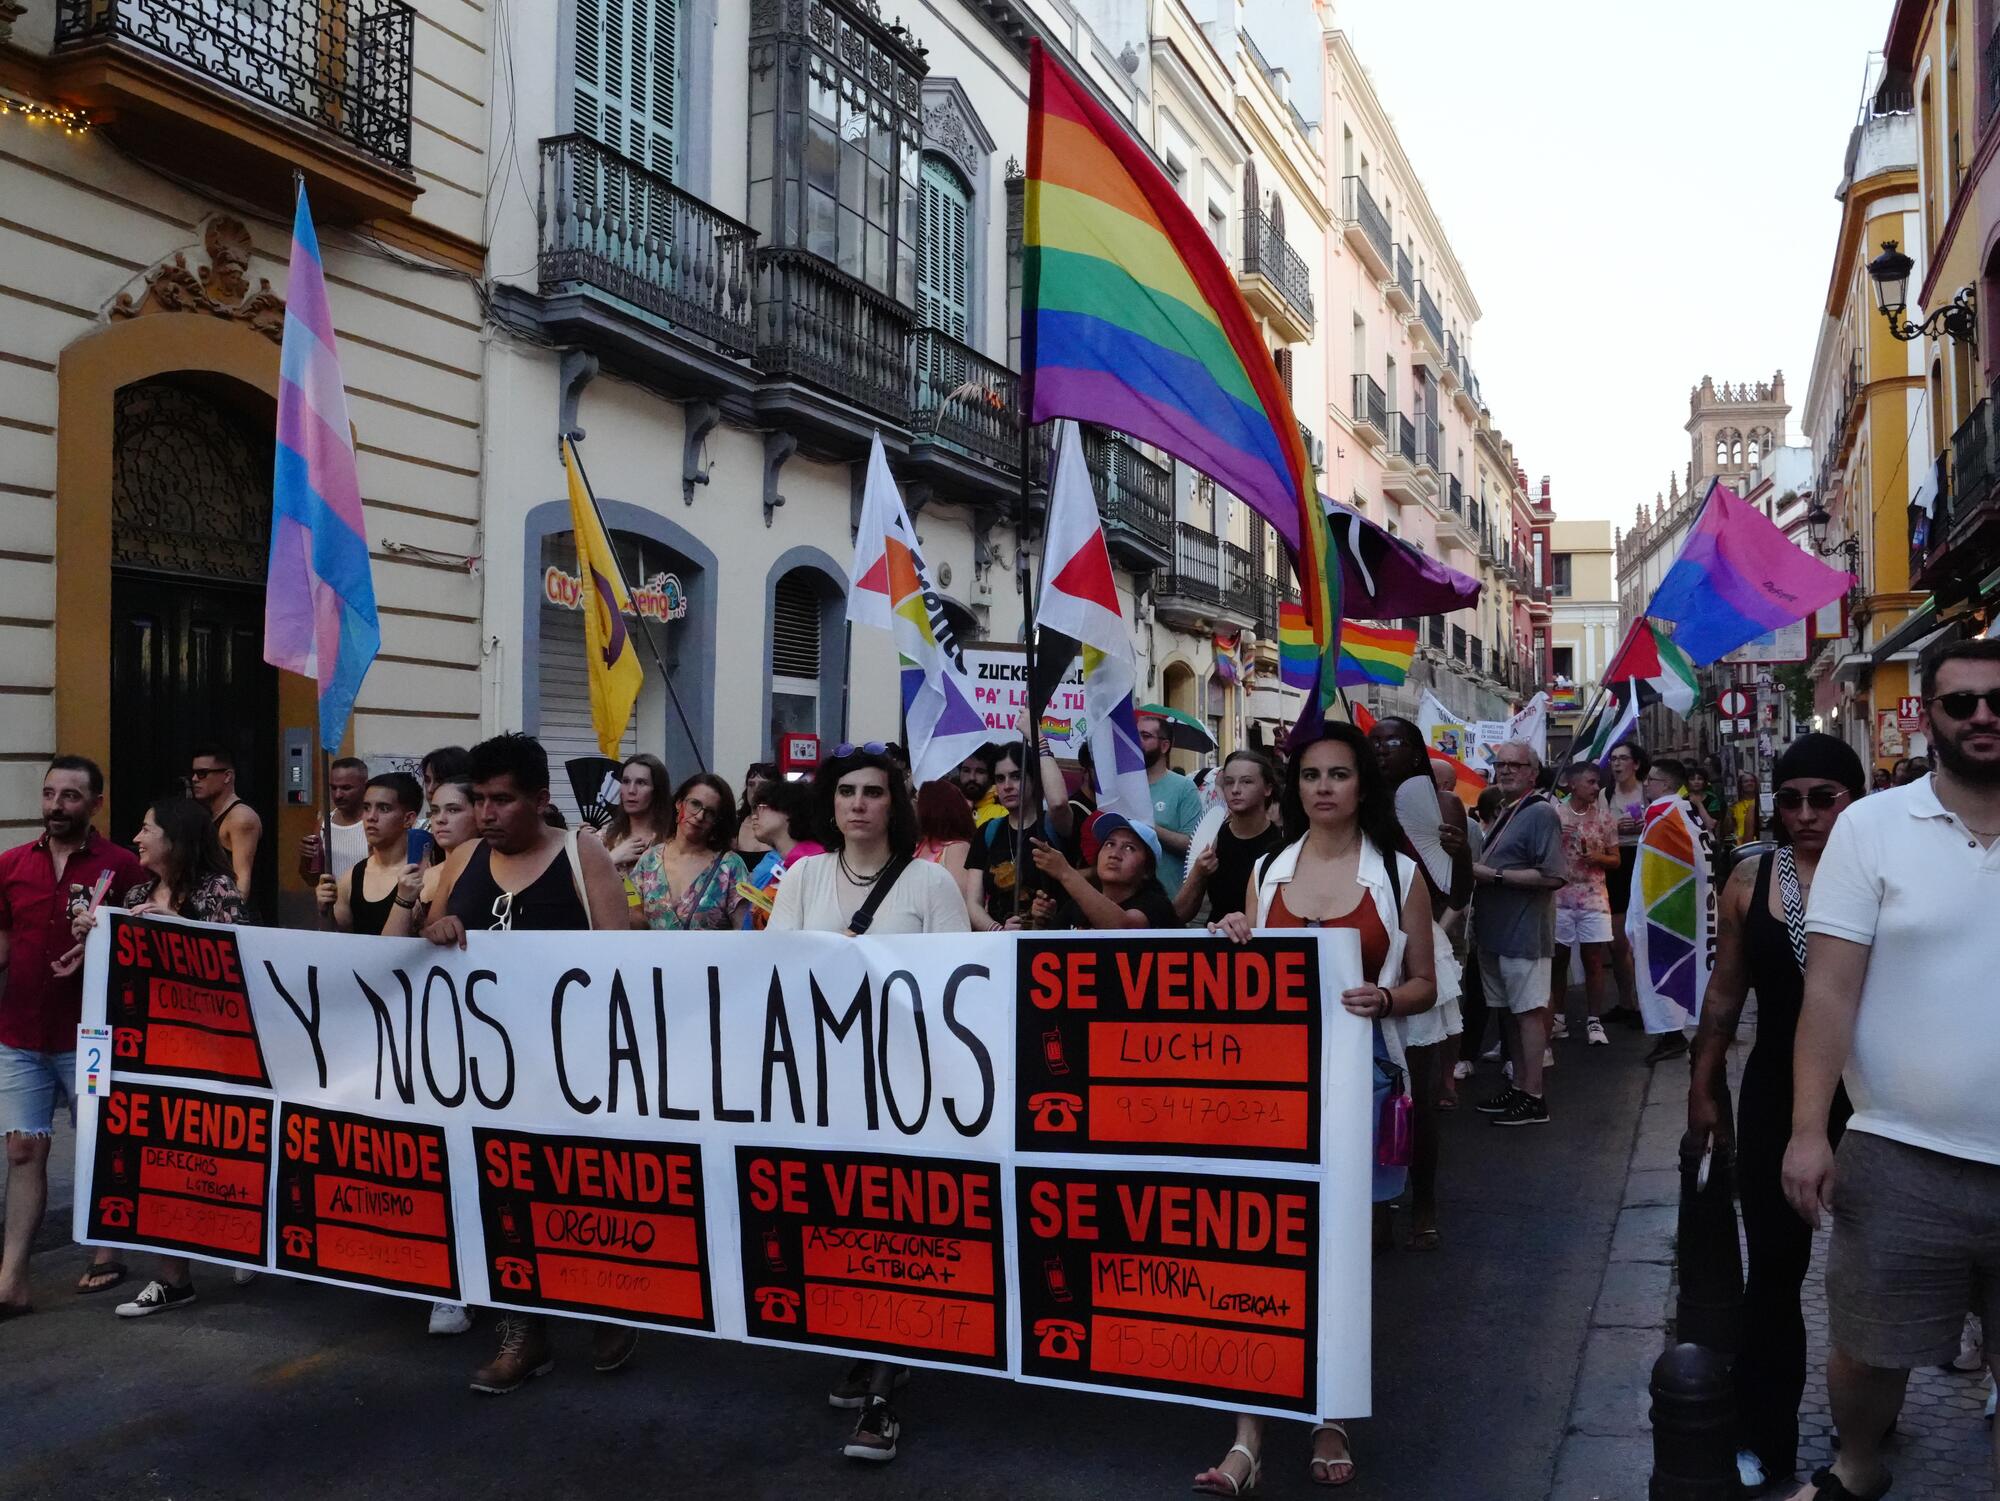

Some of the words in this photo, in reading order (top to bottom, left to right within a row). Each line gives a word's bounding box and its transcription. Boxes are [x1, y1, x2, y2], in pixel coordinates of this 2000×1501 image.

[547, 568, 582, 609] City
[117, 924, 152, 967] SE
[152, 929, 241, 984] VENDE
[158, 982, 239, 1019] COLECTIVO
[1029, 952, 1098, 1010] SE
[1115, 952, 1308, 1011] VENDE
[86, 1047, 101, 1072] 2
[263, 959, 327, 1089] Y
[352, 964, 516, 1111] NOS
[550, 963, 995, 1137] CALLAMOS
[1120, 1028, 1243, 1066] LUCHA
[106, 1090, 149, 1137] SE
[160, 1096, 267, 1153] VENDE
[1117, 1095, 1286, 1124] 954470371
[146, 1150, 218, 1176] DERECHOS
[285, 1113, 320, 1164] SE
[329, 1121, 442, 1183] VENDE
[485, 1139, 534, 1191] SE
[543, 1146, 694, 1206] VENDE
[749, 1158, 809, 1214] SE
[822, 1163, 992, 1230] VENDE
[329, 1183, 413, 1216] ACTIVISMO
[1029, 1180, 1099, 1240] SE
[1117, 1184, 1307, 1257] VENDE
[546, 1209, 655, 1253] ORGULLO
[808, 1225, 961, 1262] ASOCIACIONES
[847, 1255, 956, 1284] LGTBIQA+
[1097, 1258, 1206, 1301] MEMORIA
[1210, 1286, 1290, 1317] LGTBIQA+
